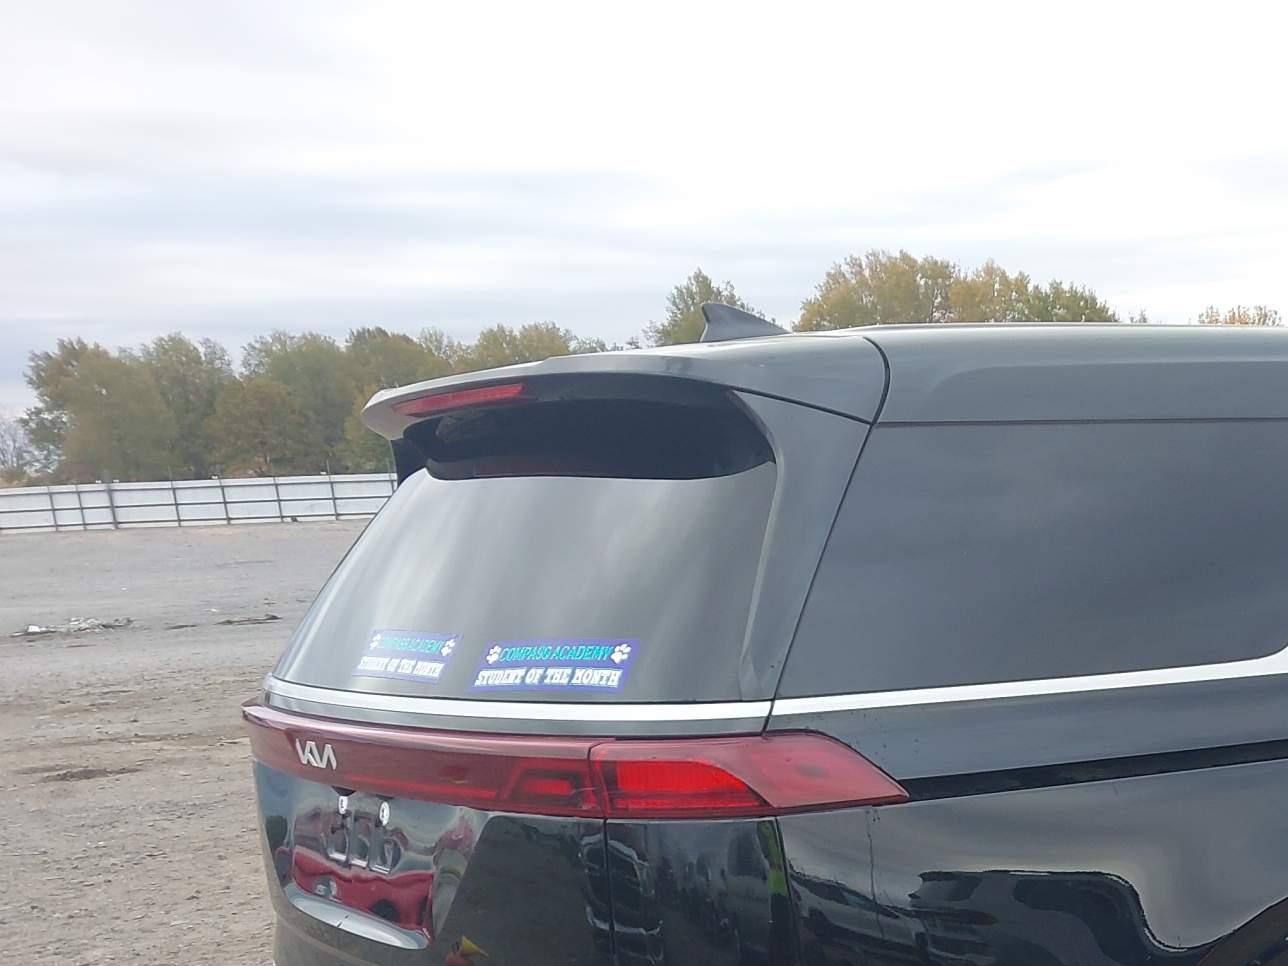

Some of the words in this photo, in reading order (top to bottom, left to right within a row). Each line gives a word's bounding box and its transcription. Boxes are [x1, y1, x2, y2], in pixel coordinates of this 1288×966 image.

[500, 645, 551, 662] COMPASS
[551, 644, 613, 661] ACADEMY
[475, 668, 527, 686] STUDENT
[525, 668, 546, 685] OF
[543, 667, 573, 686] THE
[569, 668, 623, 689] MONTH
[295, 737, 337, 771] KIA
